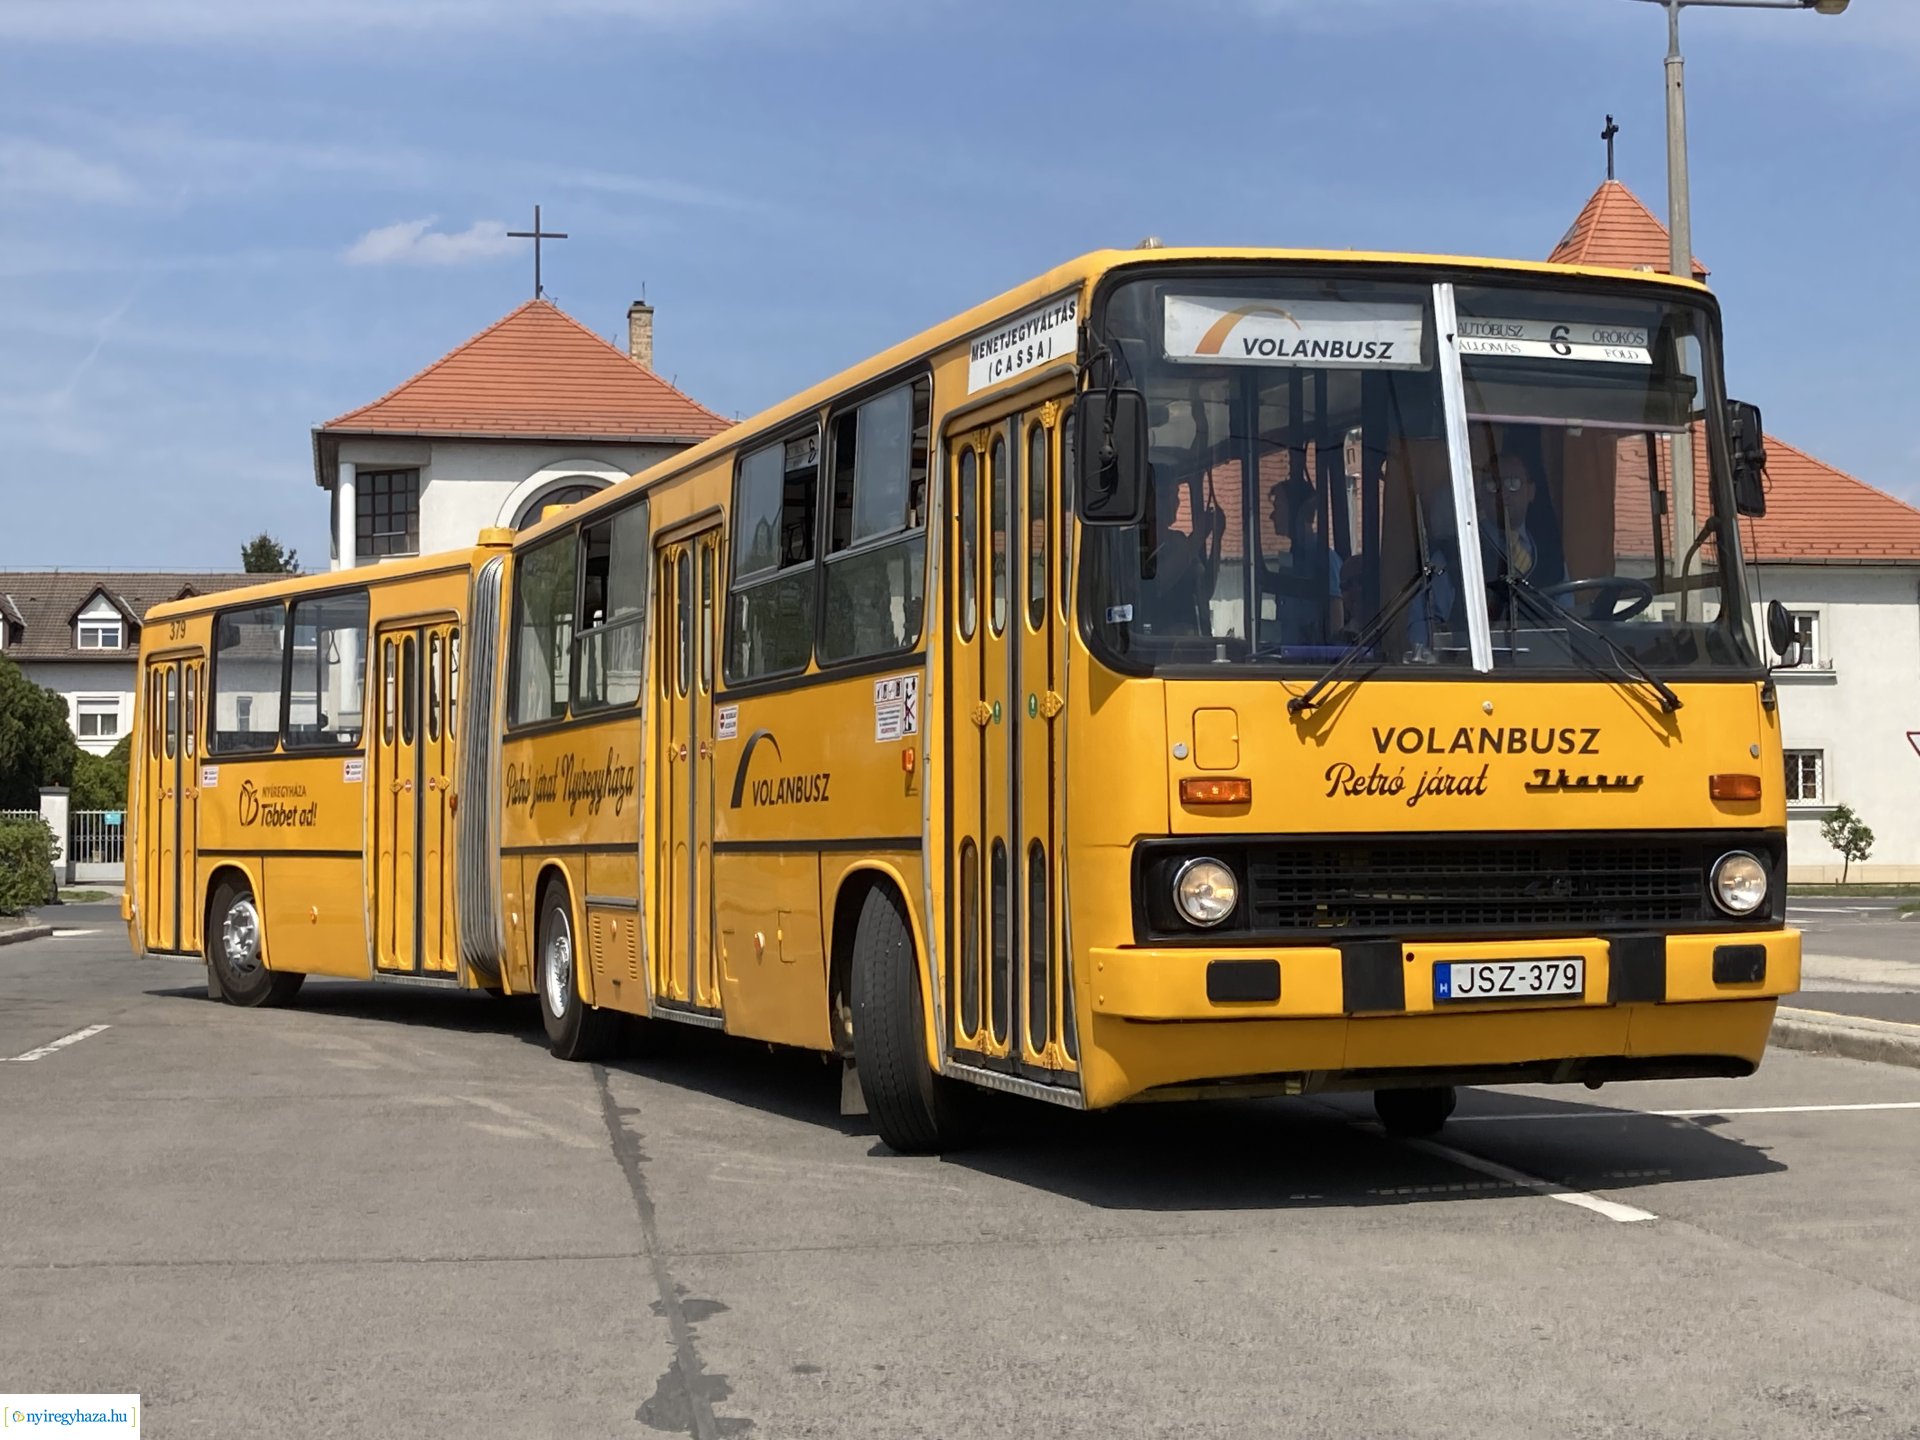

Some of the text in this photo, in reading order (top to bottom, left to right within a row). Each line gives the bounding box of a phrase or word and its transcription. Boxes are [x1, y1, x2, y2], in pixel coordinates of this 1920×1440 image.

[971, 300, 1076, 363] MENETJEGYVÁLTÁS
[1457, 321, 1524, 338] AUTÓBUSZ
[1550, 325, 1572, 356] 6
[1243, 337, 1394, 360] VOLÁNBUSZ
[1458, 340, 1521, 353] ÁLLOMÁS
[169, 619, 186, 641] 379
[1371, 727, 1602, 755] VOLÁNBUSZ
[261, 783, 307, 798] NYÍREGYHÁZA
[506, 746, 635, 820] Retró járat Nyíregyháza
[752, 773, 831, 807] VOLÁNBUSZ
[1324, 762, 1490, 808] Retró járat
[260, 801, 318, 827] Többet ad!
[1439, 963, 1577, 994] H JSZ-379
